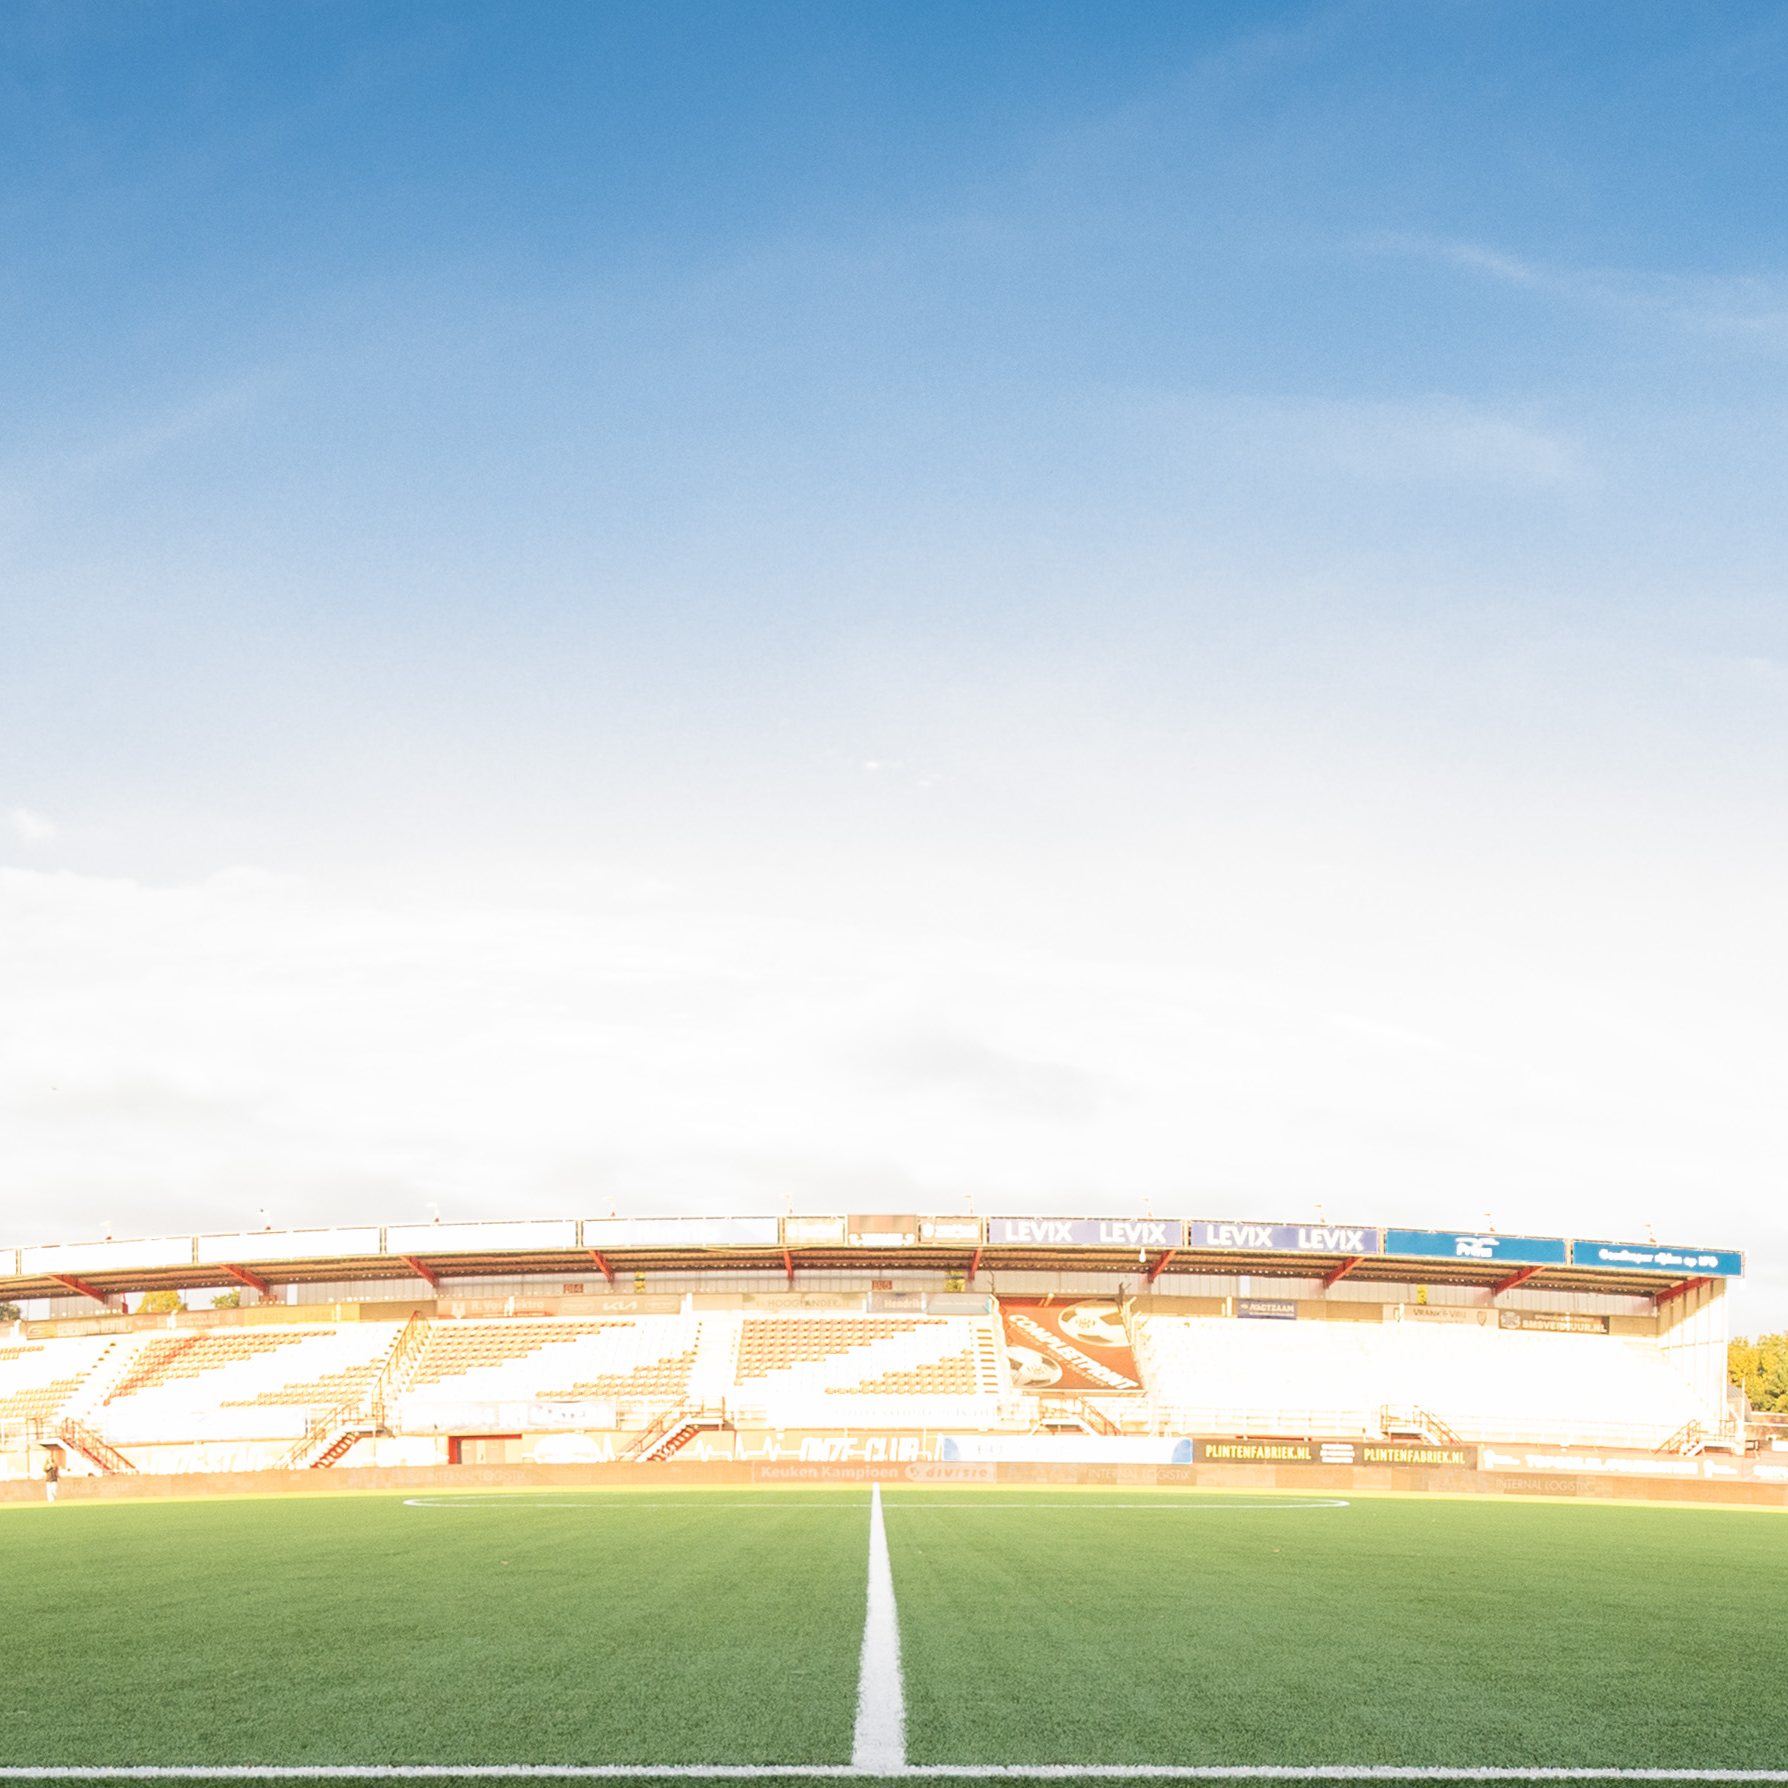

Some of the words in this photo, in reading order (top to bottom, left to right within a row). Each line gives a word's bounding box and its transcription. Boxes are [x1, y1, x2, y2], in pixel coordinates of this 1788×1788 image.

[1004, 1220, 1072, 1243] LEVIX
[1099, 1221, 1167, 1244] LEVIX
[1205, 1224, 1273, 1248] LEVIX
[1298, 1227, 1364, 1252] LEVIX
[1205, 1444, 1312, 1460] PLINTENFABRIEK.NL
[1363, 1447, 1466, 1465] PLINTENFABRIEK.NL
[761, 1465, 818, 1479] Keuken
[821, 1465, 899, 1482] Kampioen
[925, 1466, 989, 1480] divisie
